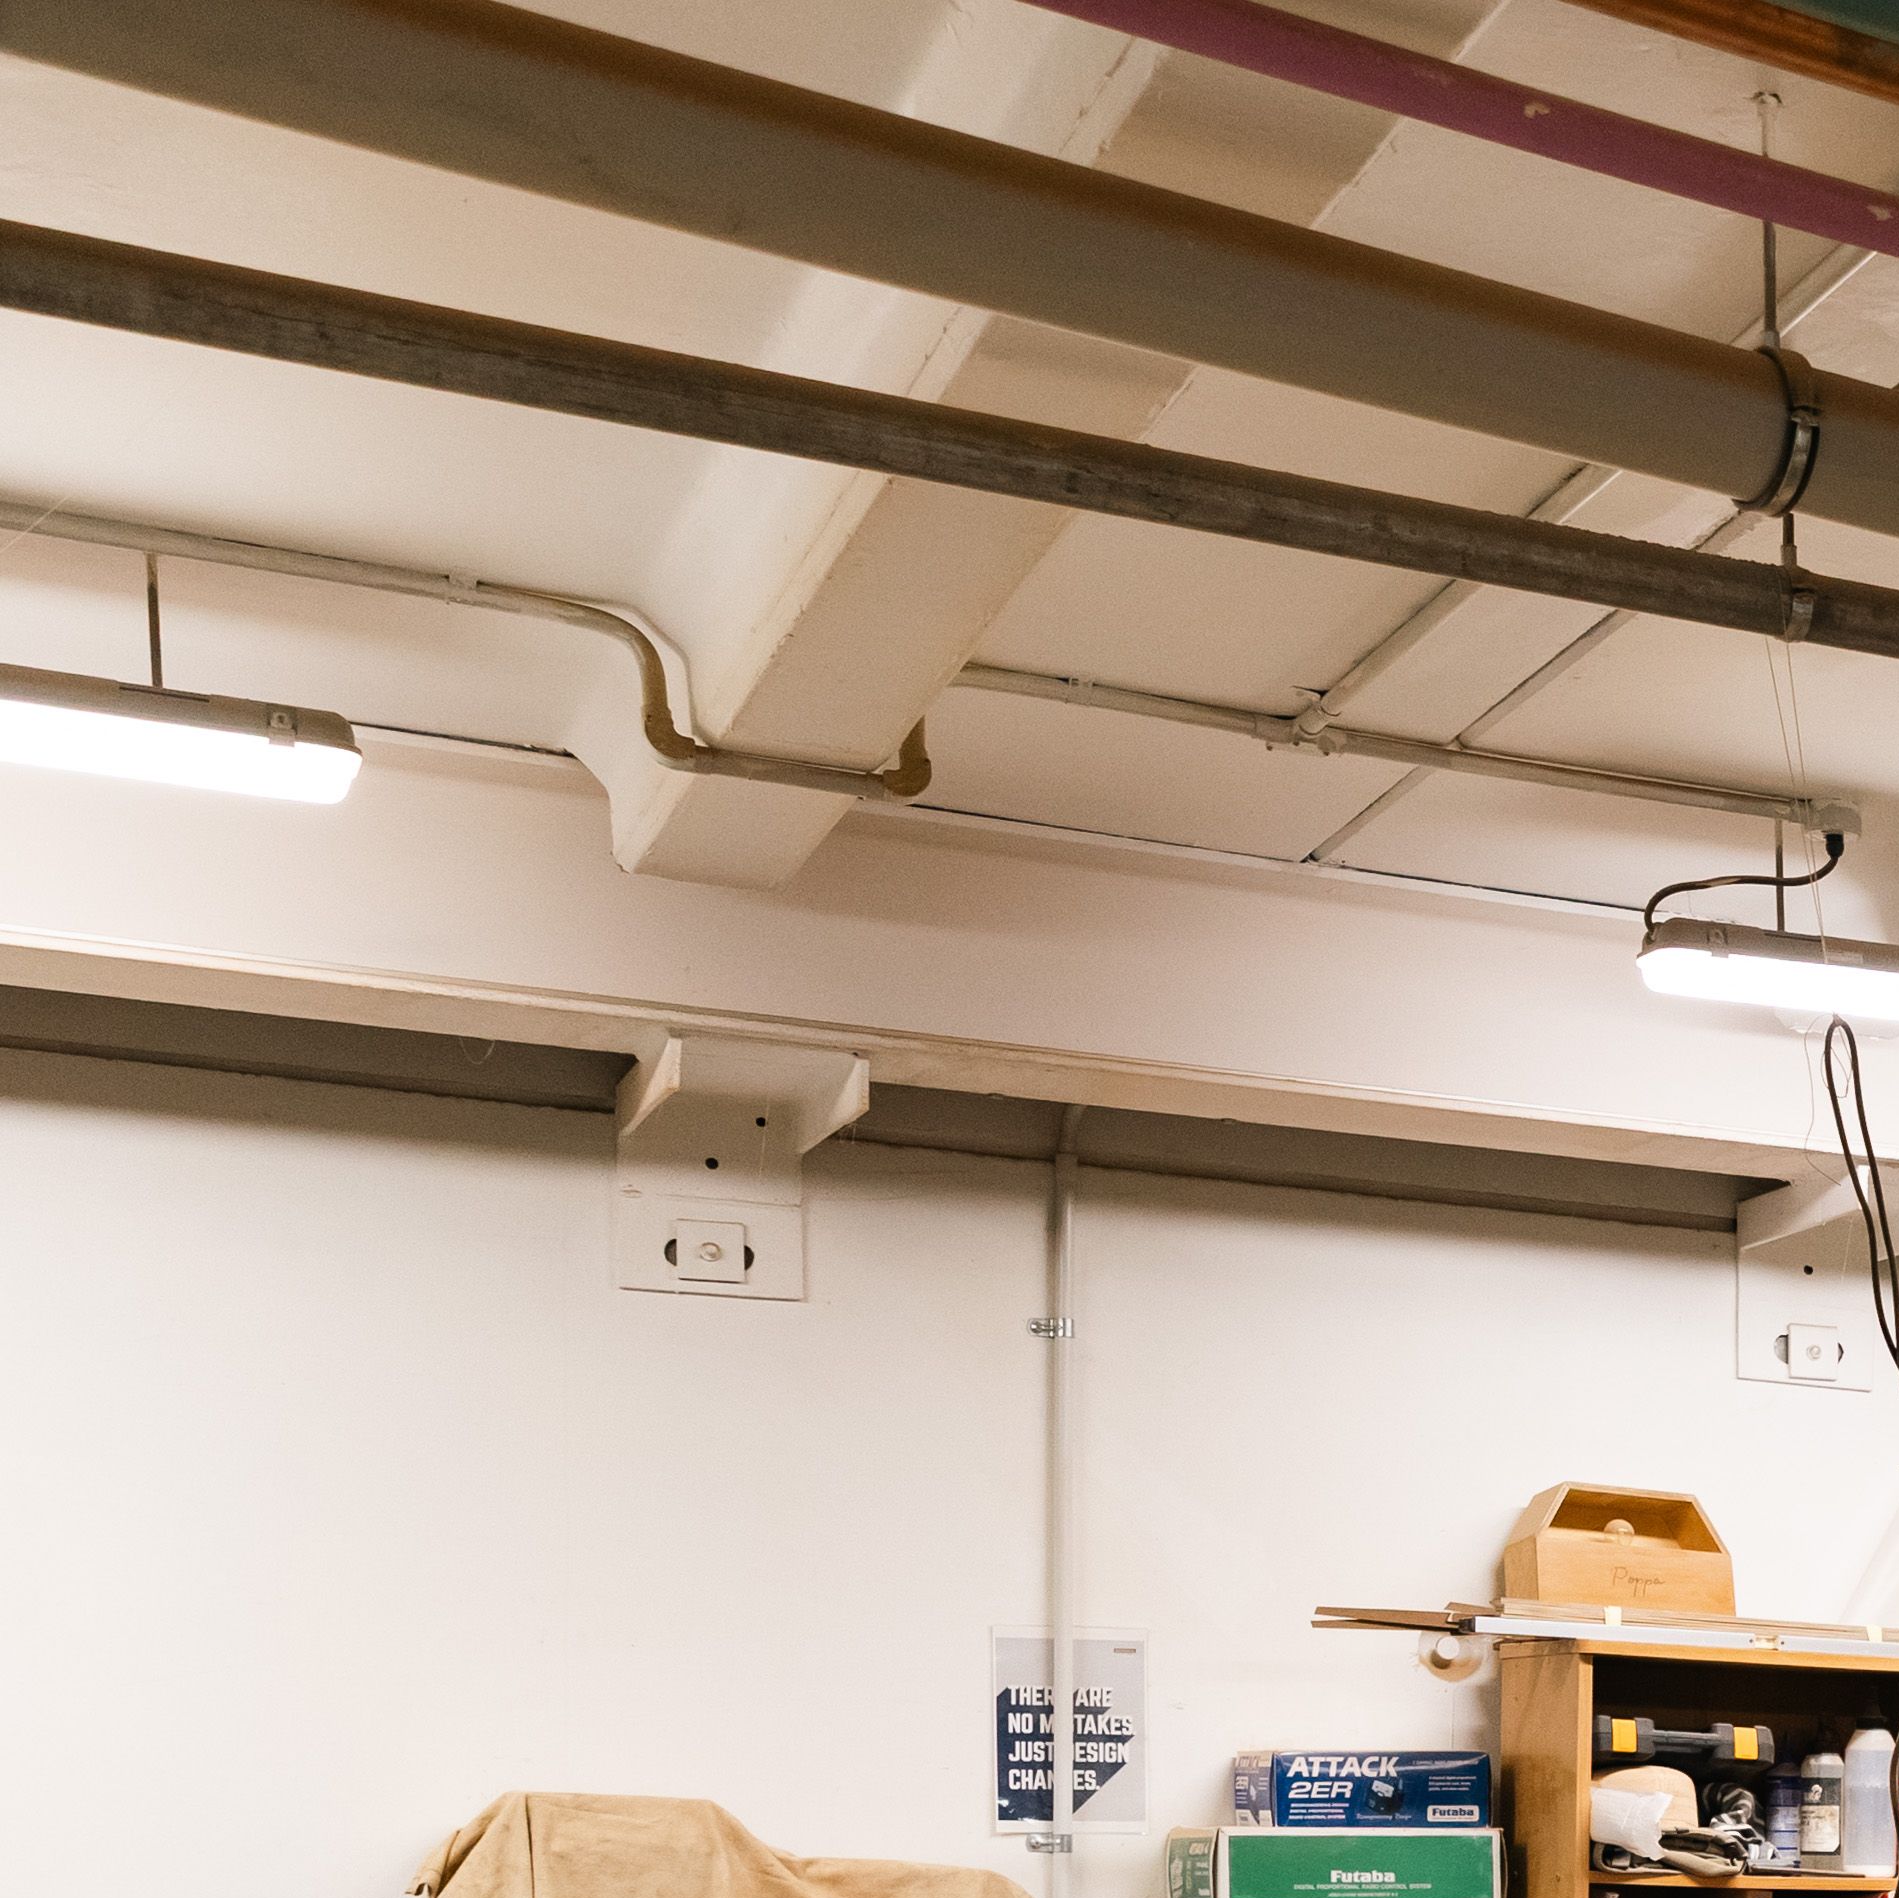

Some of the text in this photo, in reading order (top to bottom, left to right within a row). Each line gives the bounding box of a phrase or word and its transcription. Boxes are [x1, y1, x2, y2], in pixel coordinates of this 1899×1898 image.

[1008, 1686, 1114, 1707] THER ARE
[1008, 1713, 1033, 1734] NO
[1008, 1741, 1130, 1763] JUST ESIGN
[1286, 1756, 1401, 1777] ATTACK
[1008, 1769, 1100, 1790] CHANES.
[1288, 1781, 1354, 1799] 2ER
[1432, 1807, 1475, 1817] Futaba
[1330, 1869, 1396, 1883] Futaba
